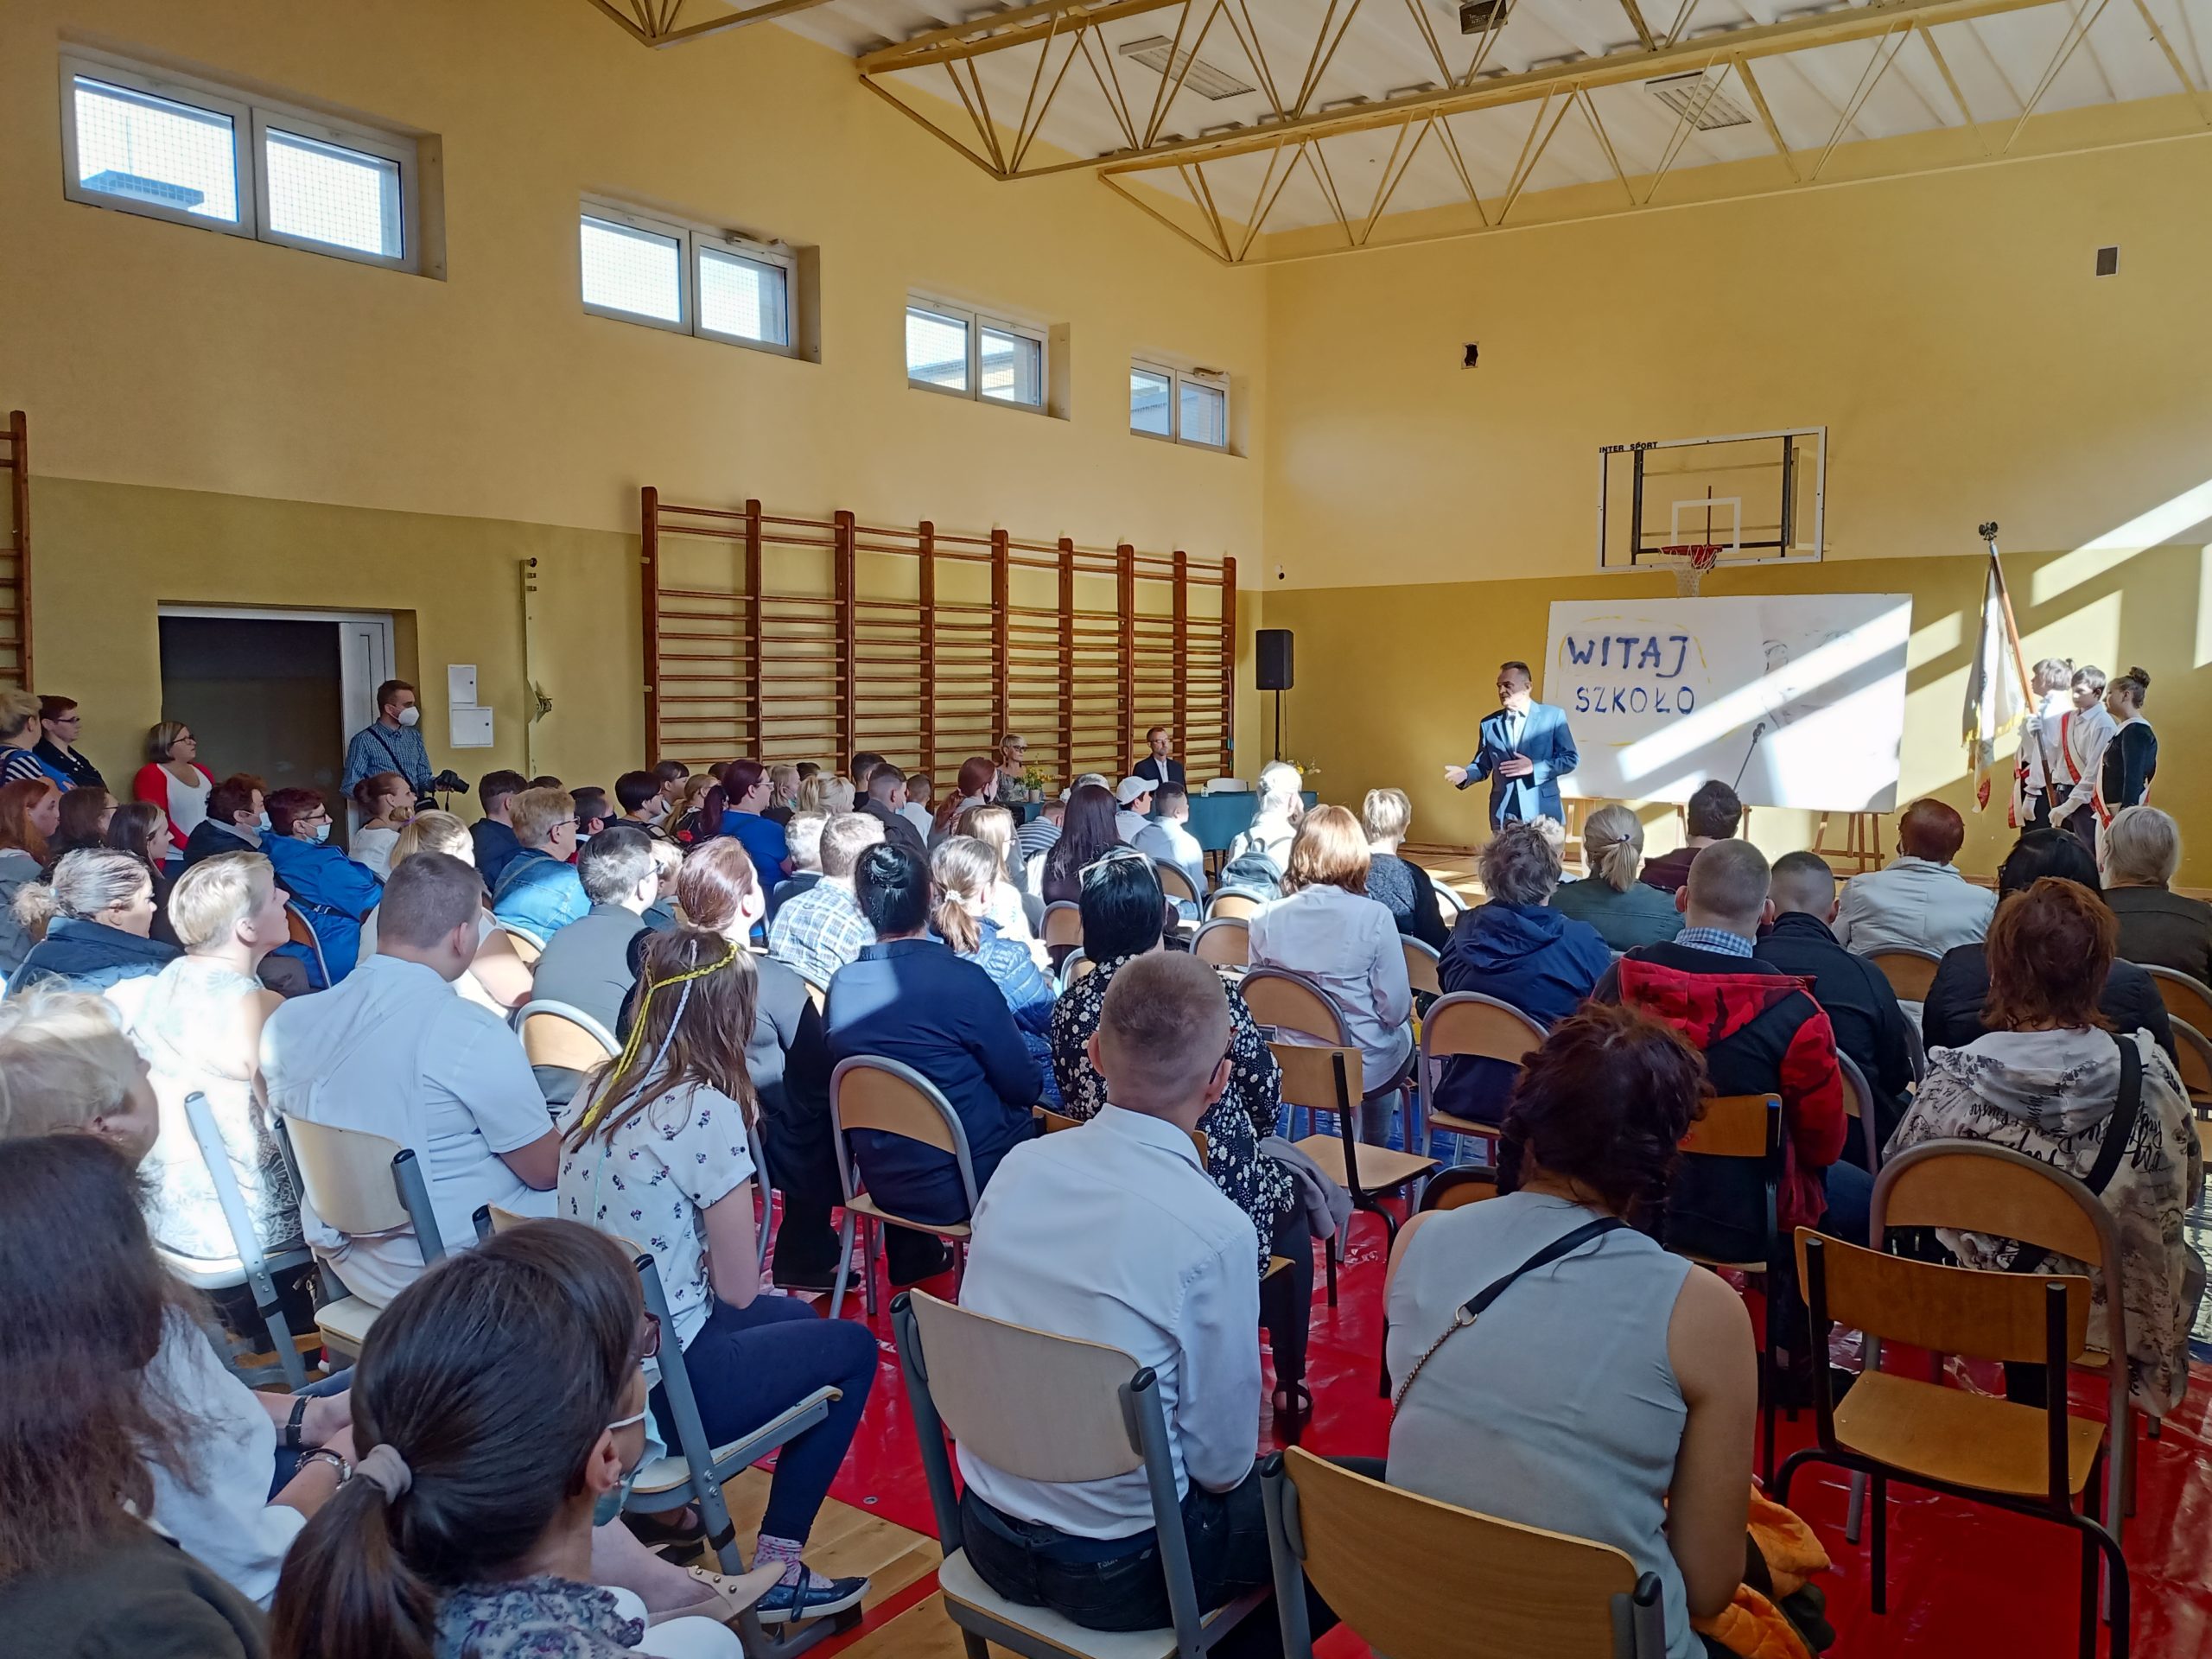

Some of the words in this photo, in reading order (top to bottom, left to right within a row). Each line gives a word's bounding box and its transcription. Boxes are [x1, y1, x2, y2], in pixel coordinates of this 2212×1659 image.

[1599, 444, 1624, 454] INTER
[1630, 442, 1658, 451] SPORT
[1567, 636, 1688, 678] WITAJ
[1575, 686, 1694, 715] SZKOŁO
